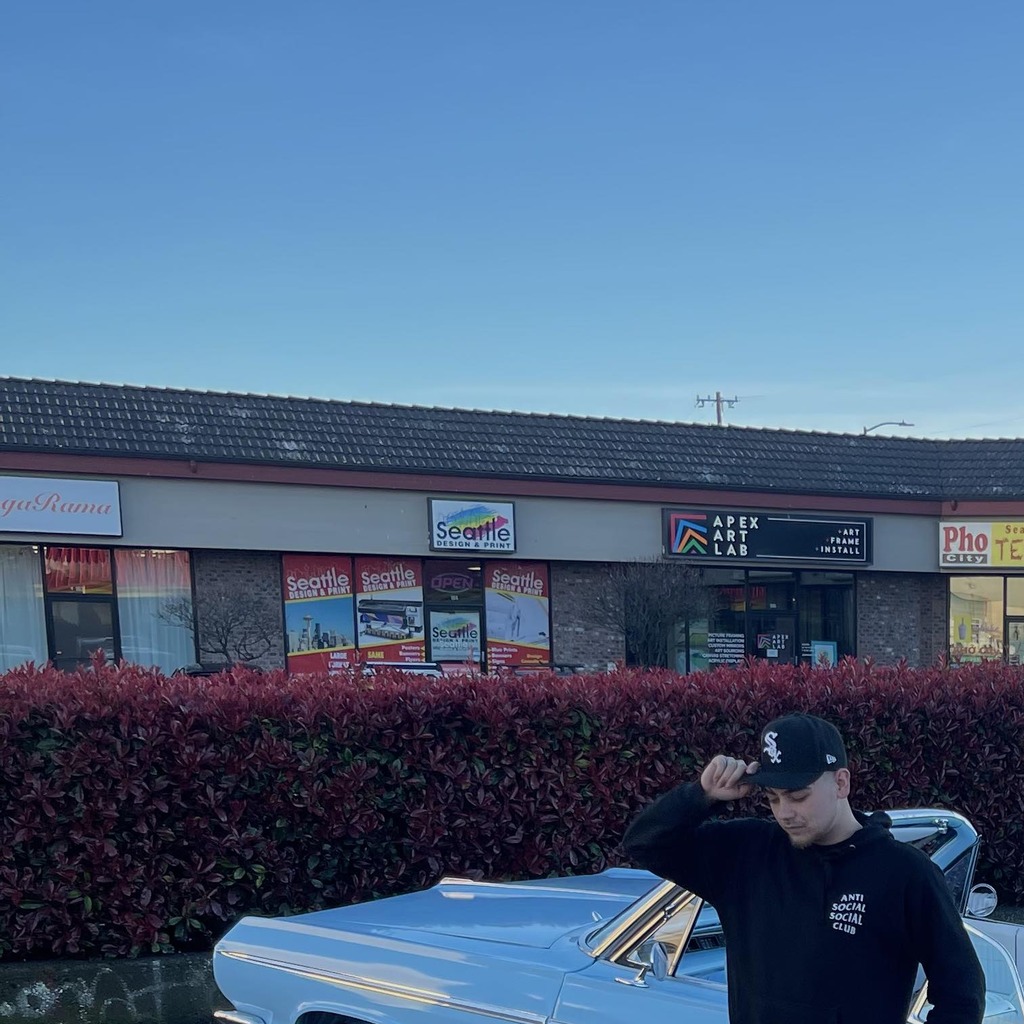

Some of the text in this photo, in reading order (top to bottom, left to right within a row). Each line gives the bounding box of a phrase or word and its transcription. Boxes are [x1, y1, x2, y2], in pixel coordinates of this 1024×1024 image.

[436, 515, 511, 541] Seattle
[712, 515, 759, 529] APEX
[713, 529, 748, 542] ART
[943, 526, 988, 552] Pho
[436, 540, 470, 548] DESIGN
[714, 542, 748, 556] LAB
[287, 567, 349, 592] Seattle
[361, 564, 415, 586] Seattle
[492, 569, 544, 590] Seattle
[363, 584, 389, 593] DESIGN
[396, 579, 417, 588] PRINT
[431, 577, 473, 590] OPEN
[491, 582, 516, 592] DESIGN
[523, 587, 544, 596] PRINT
[288, 590, 318, 600] DESIGN
[328, 585, 351, 595] PRINT
[432, 624, 478, 639] Seattle
[840, 893, 864, 903] ANTI
[831, 902, 867, 913] SOCIAL
[829, 911, 863, 926] SOCIAL
[832, 922, 857, 935] CLUB
